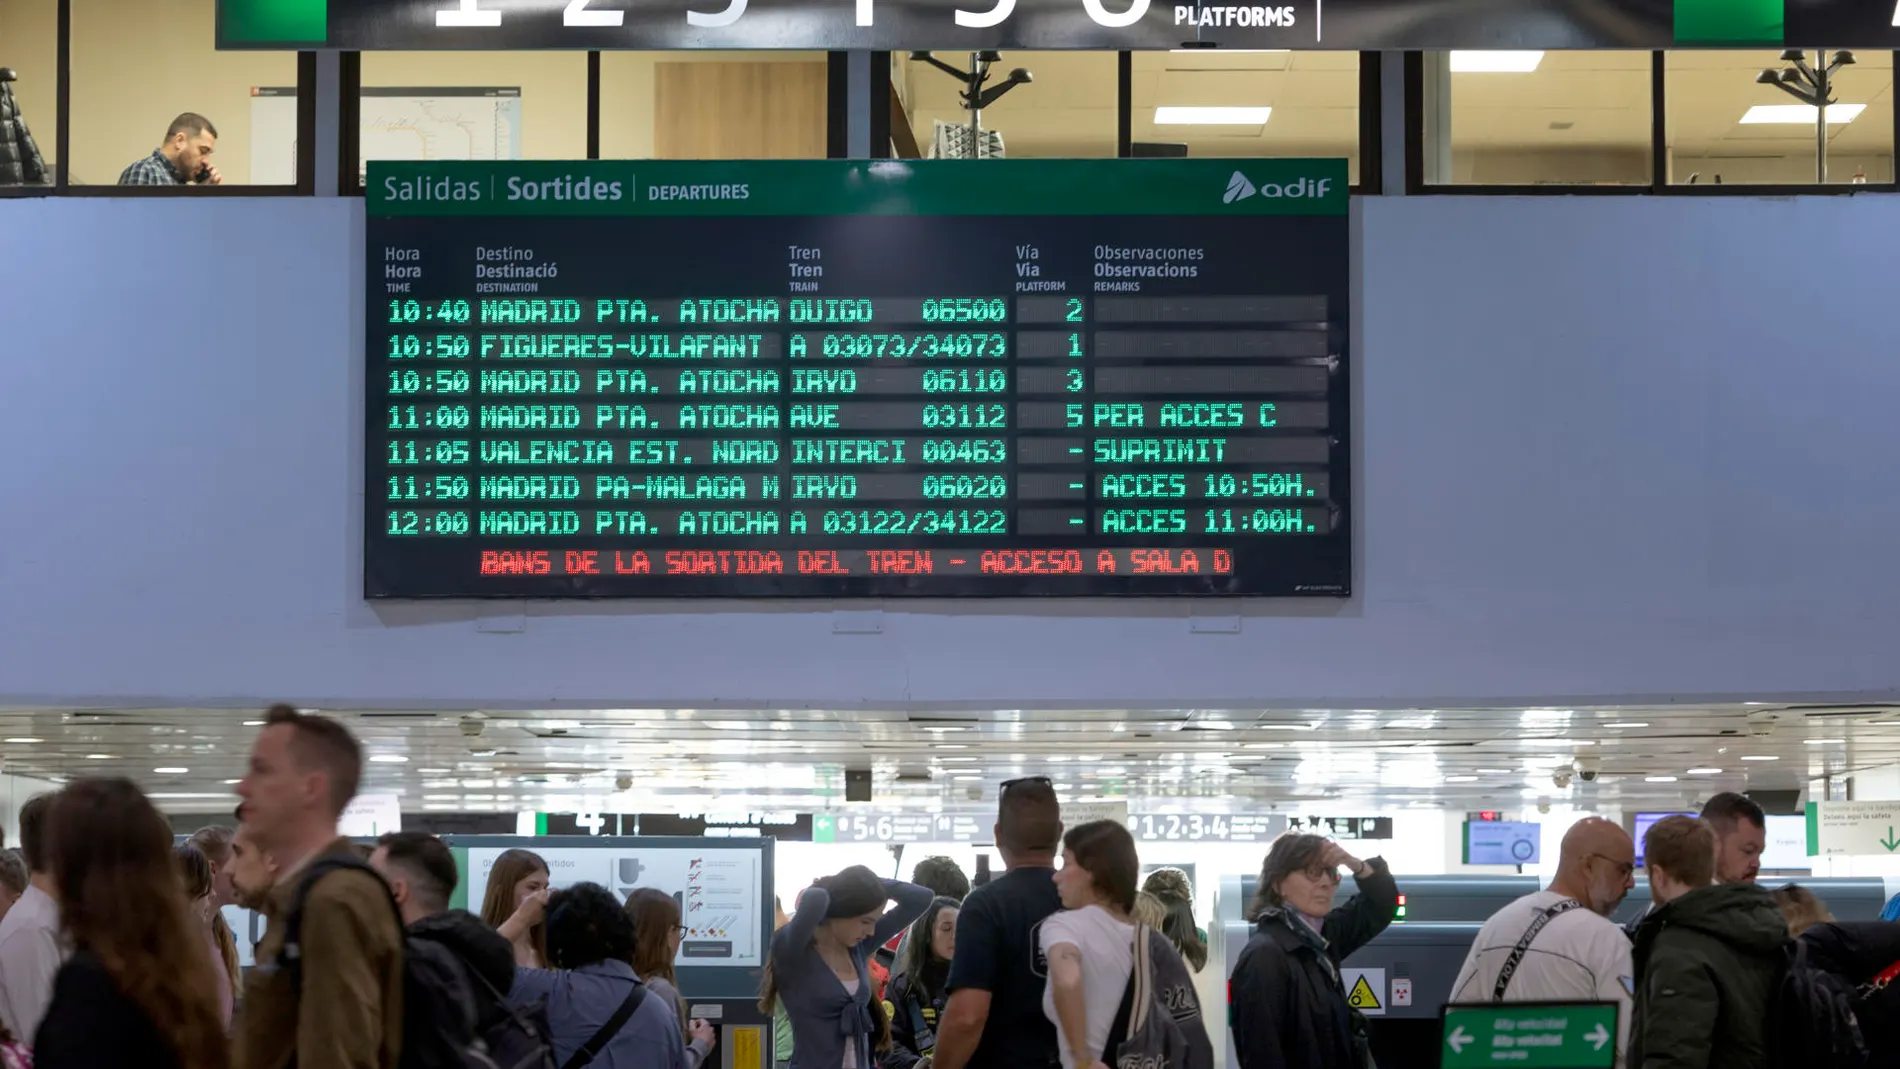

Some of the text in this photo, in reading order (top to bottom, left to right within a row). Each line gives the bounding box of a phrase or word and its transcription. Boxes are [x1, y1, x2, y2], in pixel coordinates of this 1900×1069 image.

[1174, 6, 1295, 27] PLATFORMS
[384, 176, 481, 201] Salidas
[507, 175, 623, 201] Sortides
[648, 183, 750, 201] DEPARTURES
[1260, 177, 1332, 198] adif
[385, 247, 420, 261] Hora
[476, 246, 534, 261] Destino
[788, 245, 821, 260] Tren
[1015, 245, 1039, 260] Vía
[1093, 245, 1204, 260] Observaciones
[385, 265, 422, 279] Hora
[475, 263, 558, 279] Destinació
[788, 263, 823, 278] Tren
[1015, 264, 1040, 278] Via
[1093, 263, 1198, 278] Observacions
[385, 283, 411, 293] TIME
[476, 283, 538, 293] DESTINATION
[788, 281, 818, 292] TRAIN
[1015, 281, 1066, 292] PLATFORM
[1093, 282, 1141, 292] REMARKS
[389, 299, 1083, 323] 10:40 MADRID PTA. ATOCHA OUIGO 06500 2
[389, 334, 1083, 358] 10:50 FIGUERES-VILAFANT A 03073/34073 1
[389, 369, 1083, 393] 10:50 MADRID PTA. ATOCHA IRYO 06110 3
[389, 404, 1277, 428] 11:00 MADRID PTA. ATOCHA AVE 03112 5 PER ACCES C
[389, 440, 470, 464] 11:05
[480, 440, 613, 463] VALENCIA
[629, 440, 692, 464] EST.
[713, 440, 779, 463] NORD
[792, 440, 906, 464] INTERCI
[923, 440, 1006, 463] 00463
[1094, 439, 1227, 462] SUPRIMIT
[389, 476, 470, 499] 11:50
[480, 476, 580, 499] MADRID
[596, 475, 747, 499] PA-MALAGA
[762, 476, 779, 499] M
[792, 476, 857, 499] IRYO
[923, 475, 1006, 498] 06020
[1102, 474, 1186, 498] ACCES
[1204, 474, 1315, 498] 10:50H.
[389, 511, 469, 535] 12:00
[480, 511, 580, 534] MADRID
[596, 511, 658, 534] PTA.
[679, 511, 779, 534] ATOCHA
[790, 511, 807, 534] A
[823, 510, 1006, 534] 03122/34122
[1102, 509, 1187, 533] ACCES
[1204, 509, 1315, 533] 11:00H.
[480, 551, 551, 575] BANS
[565, 551, 601, 575] DE
[615, 551, 651, 575] LA
[665, 551, 784, 575] SORTIDA
[797, 551, 850, 574] DEL
[866, 551, 934, 574] TREN
[981, 550, 1084, 574] ACCESO
[1097, 550, 1117, 573] A
[1130, 550, 1200, 574] SALA
[1213, 550, 1231, 573] D
